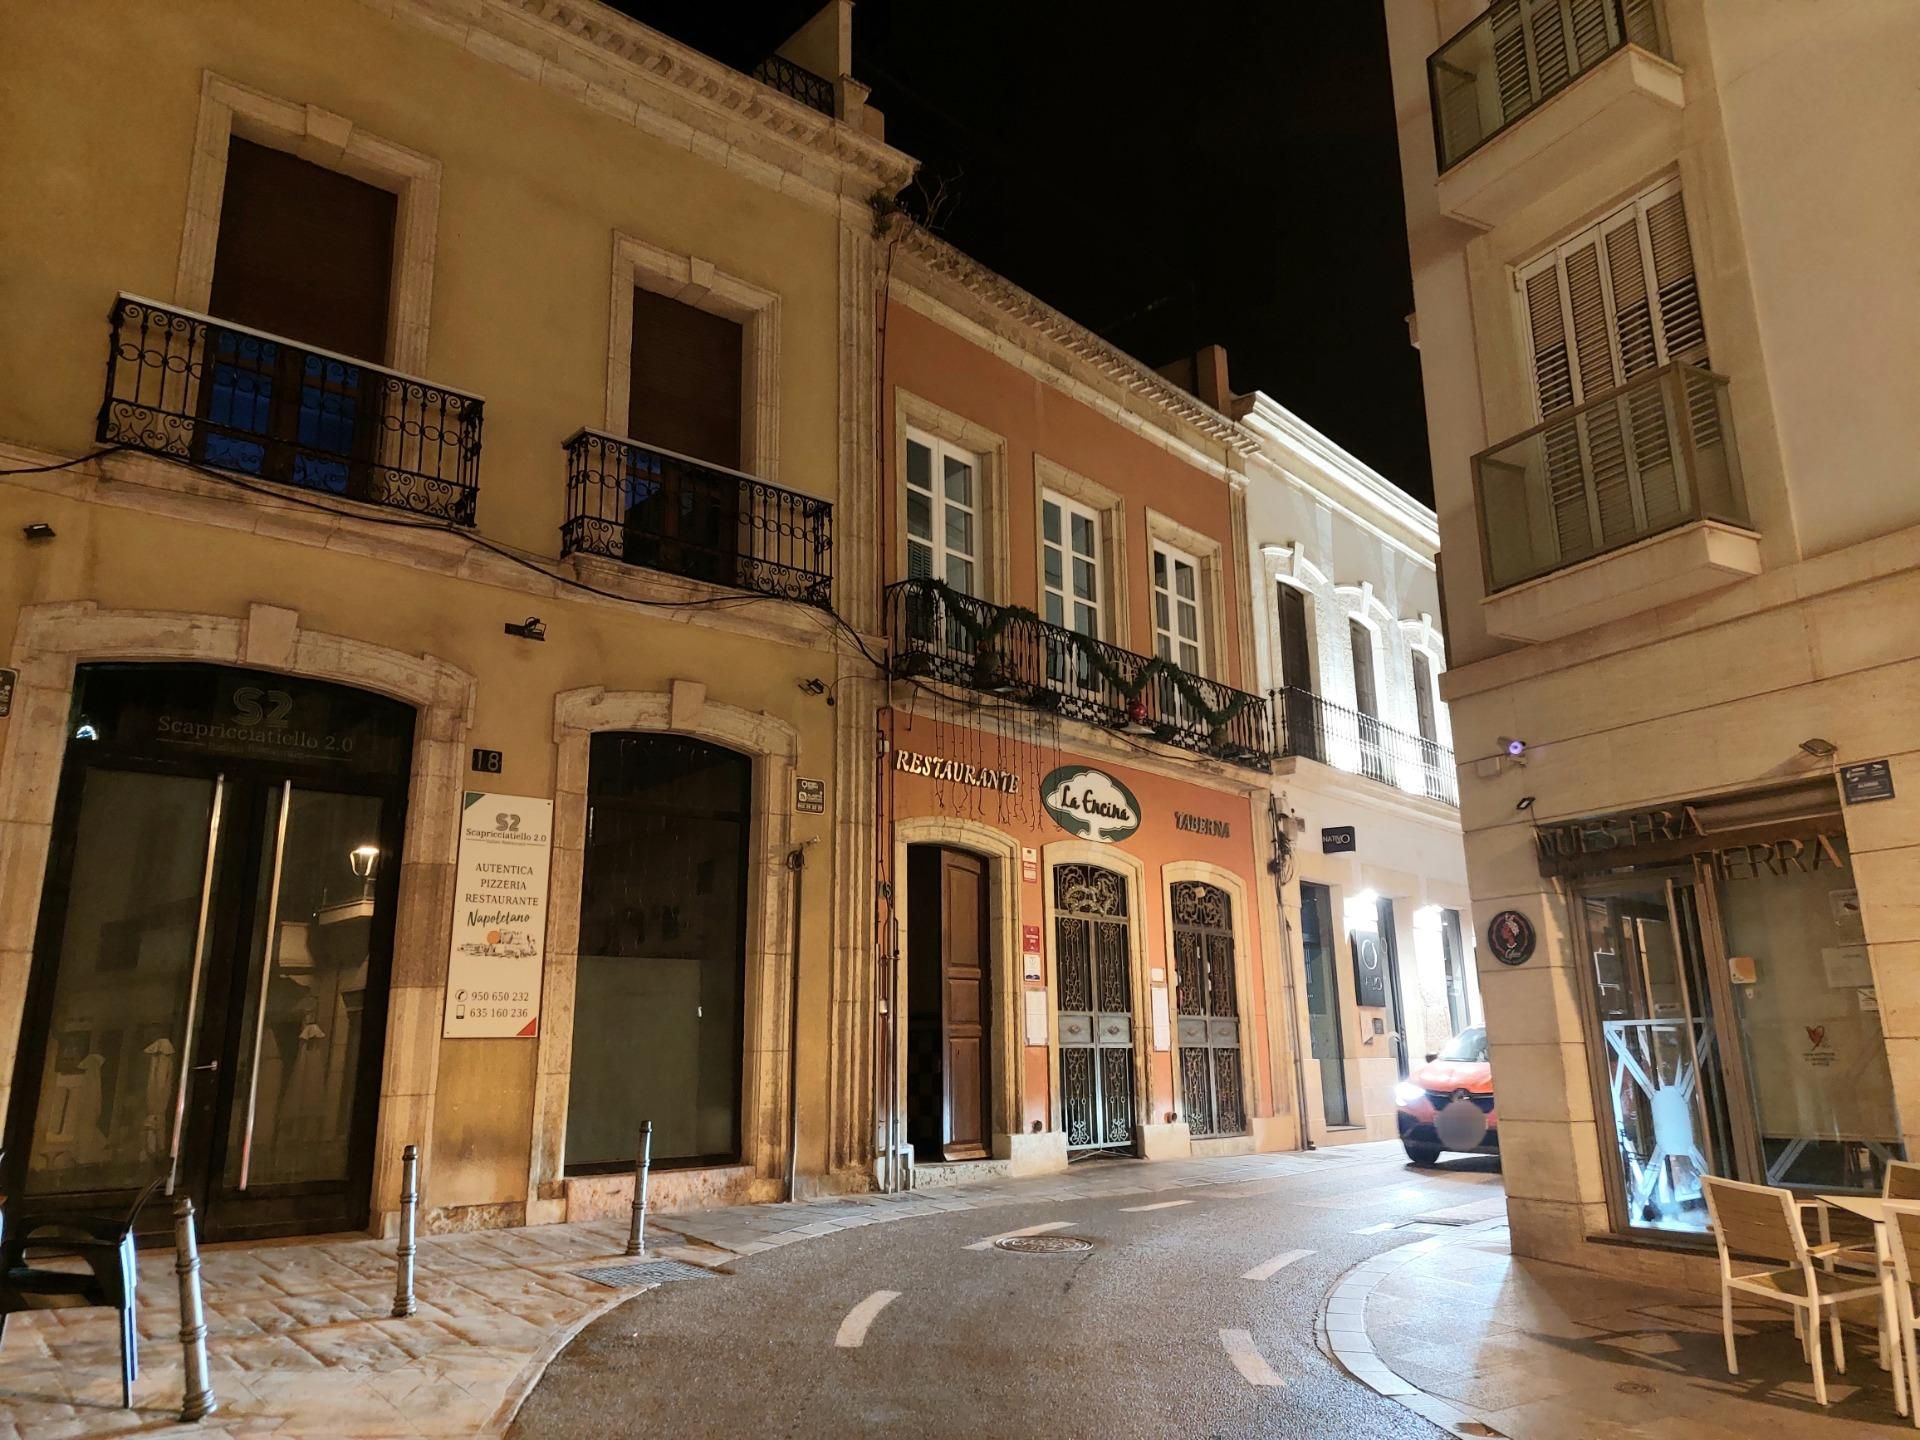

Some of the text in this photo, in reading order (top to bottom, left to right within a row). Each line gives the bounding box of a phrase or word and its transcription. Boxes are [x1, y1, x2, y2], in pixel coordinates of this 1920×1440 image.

[231, 686, 293, 728] S2
[157, 715, 319, 749] Scapricciatiello
[324, 735, 353, 753] 2.0
[477, 750, 500, 772] 18
[896, 749, 1020, 793] RESTAURANTE
[1061, 784, 1130, 821] La Encina
[495, 812, 521, 832] S2
[1174, 811, 1231, 838] TABERNA
[1536, 805, 1709, 858] NUESTRA
[1692, 833, 1844, 881] TIERRA
[475, 863, 534, 876] AUTENTICA
[480, 878, 527, 891] PIZZERIA
[465, 893, 539, 906] RESTAURANTE
[467, 908, 530, 928] Napoletano
[471, 991, 529, 1002] 950 650 232
[470, 1008, 528, 1018] 635 160 236
